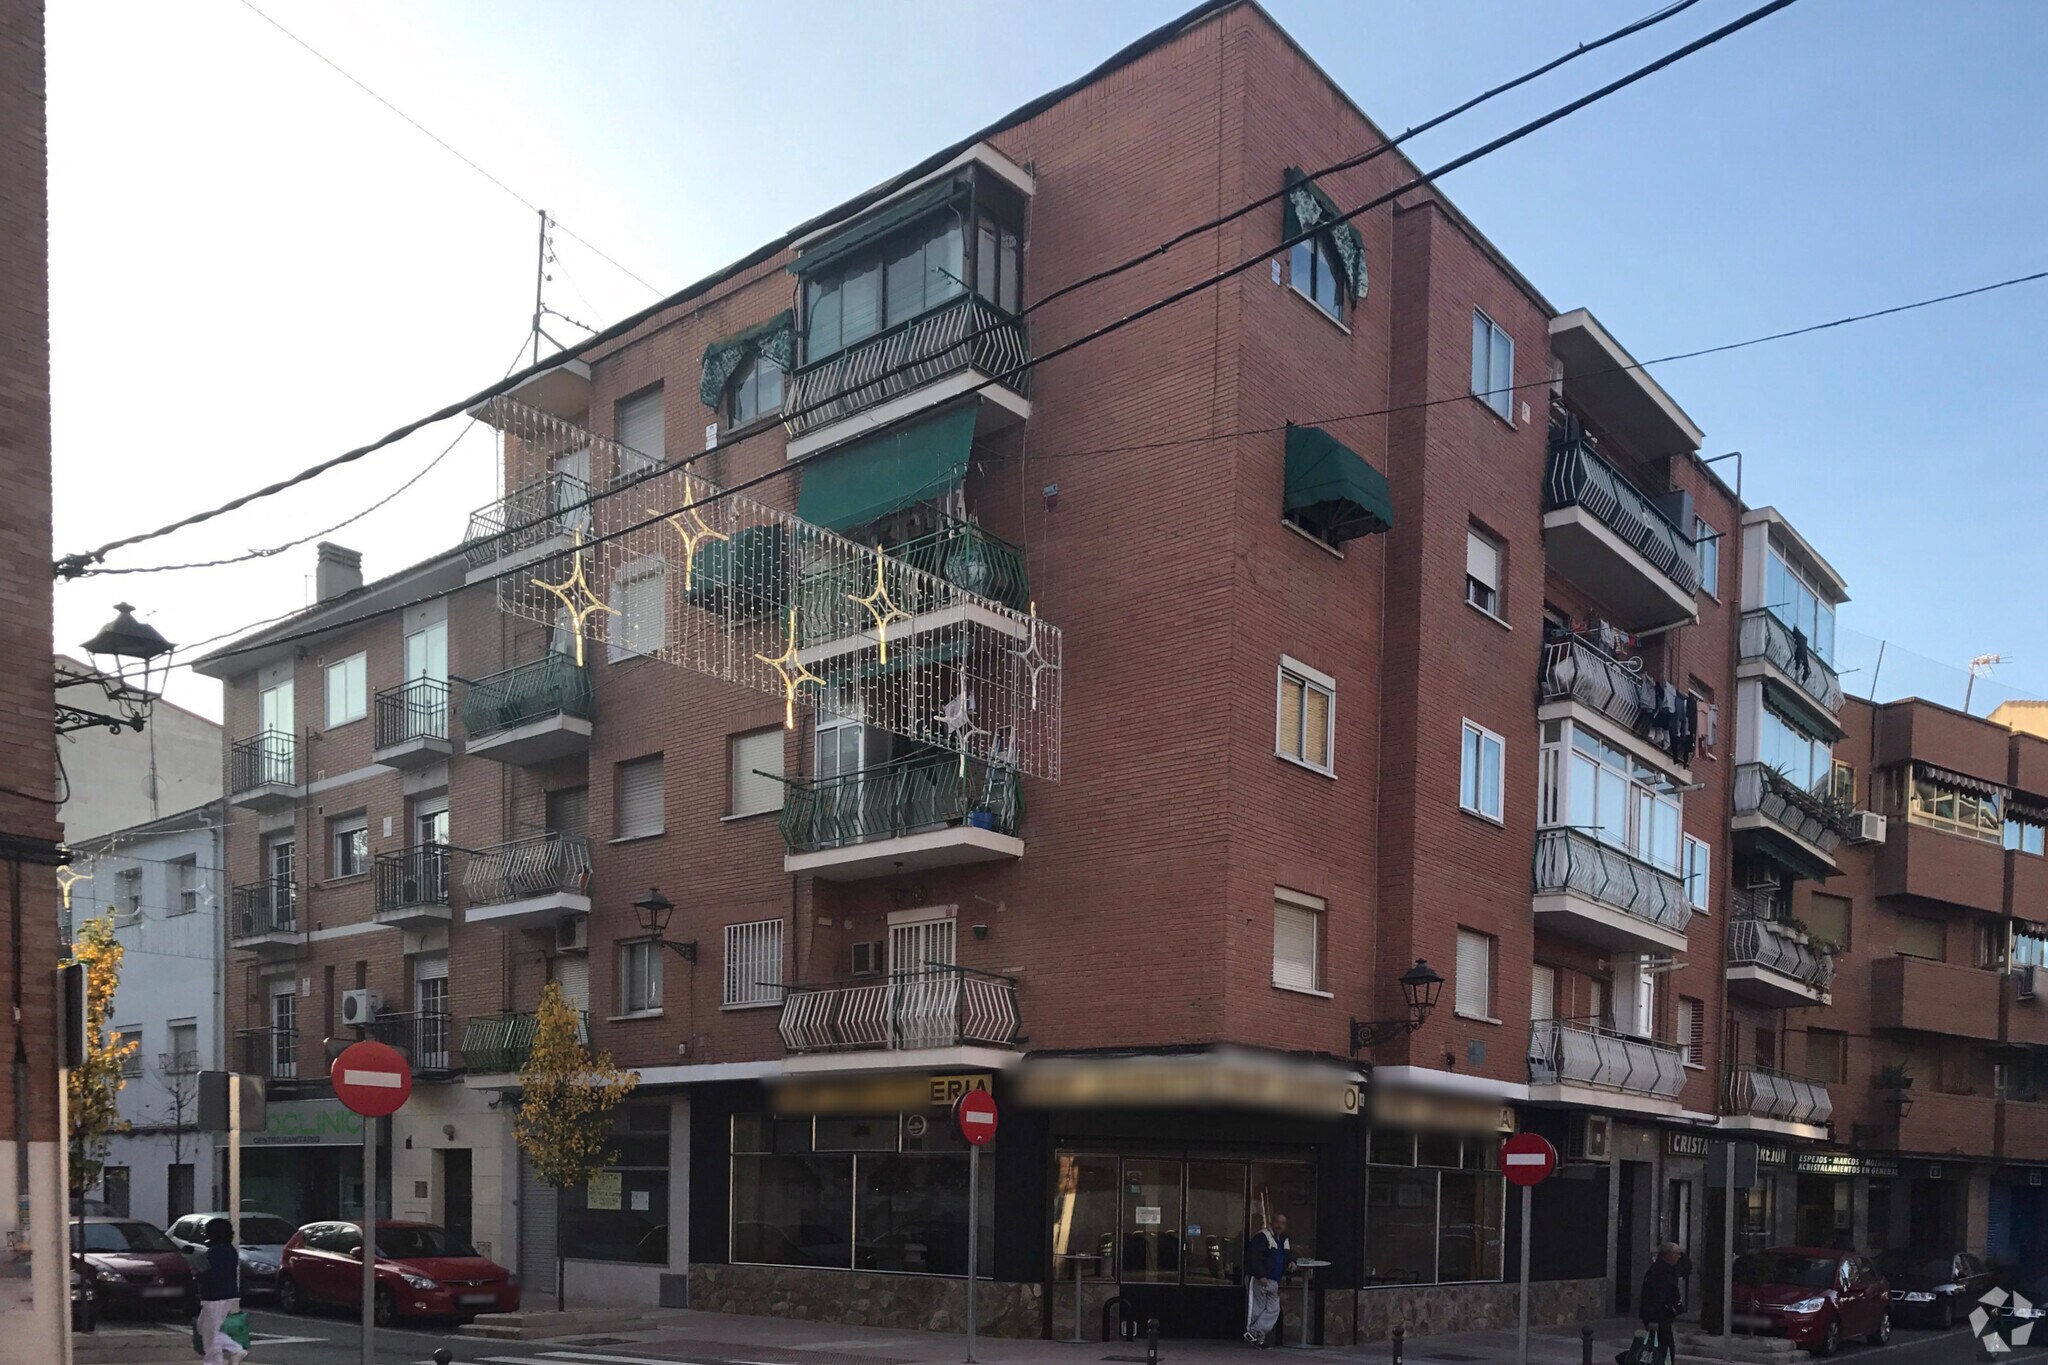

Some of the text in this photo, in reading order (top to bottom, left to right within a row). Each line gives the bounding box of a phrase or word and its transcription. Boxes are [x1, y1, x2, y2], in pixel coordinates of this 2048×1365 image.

[253, 1135, 321, 1144] CENTRO SANITARIO
[1673, 1134, 1787, 1164] CRISTA REJON
[1799, 1154, 1828, 1164] ESPEJOS
[1832, 1156, 1860, 1166] MARCOS
[1797, 1162, 1861, 1174] ACRISTALAMIENTOS
[1861, 1166, 1870, 1174] EN
